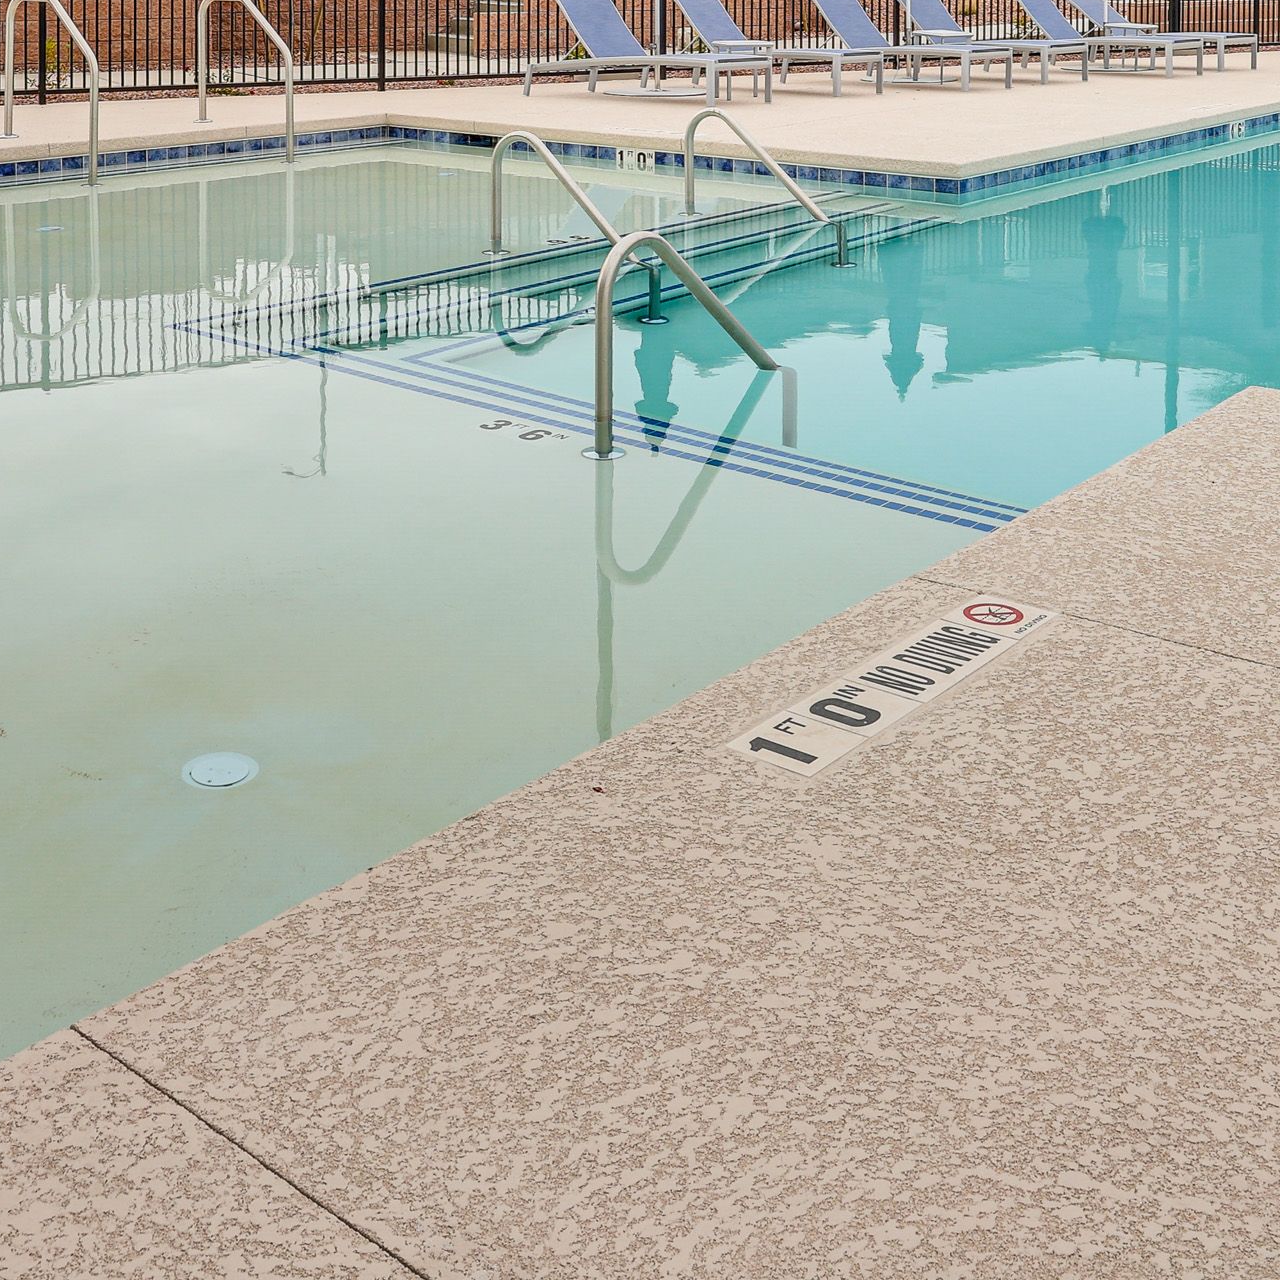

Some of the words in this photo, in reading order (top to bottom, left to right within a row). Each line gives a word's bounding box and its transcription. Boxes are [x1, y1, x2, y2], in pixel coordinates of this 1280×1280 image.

[480, 419, 512, 430] 3
[518, 429, 552, 441] 6
[892, 625, 1002, 675] DIVING
[832, 684, 866, 700] IN
[859, 665, 936, 696] NO
[809, 697, 882, 727] 0
[773, 717, 807, 736] FT
[749, 736, 819, 764] 1
